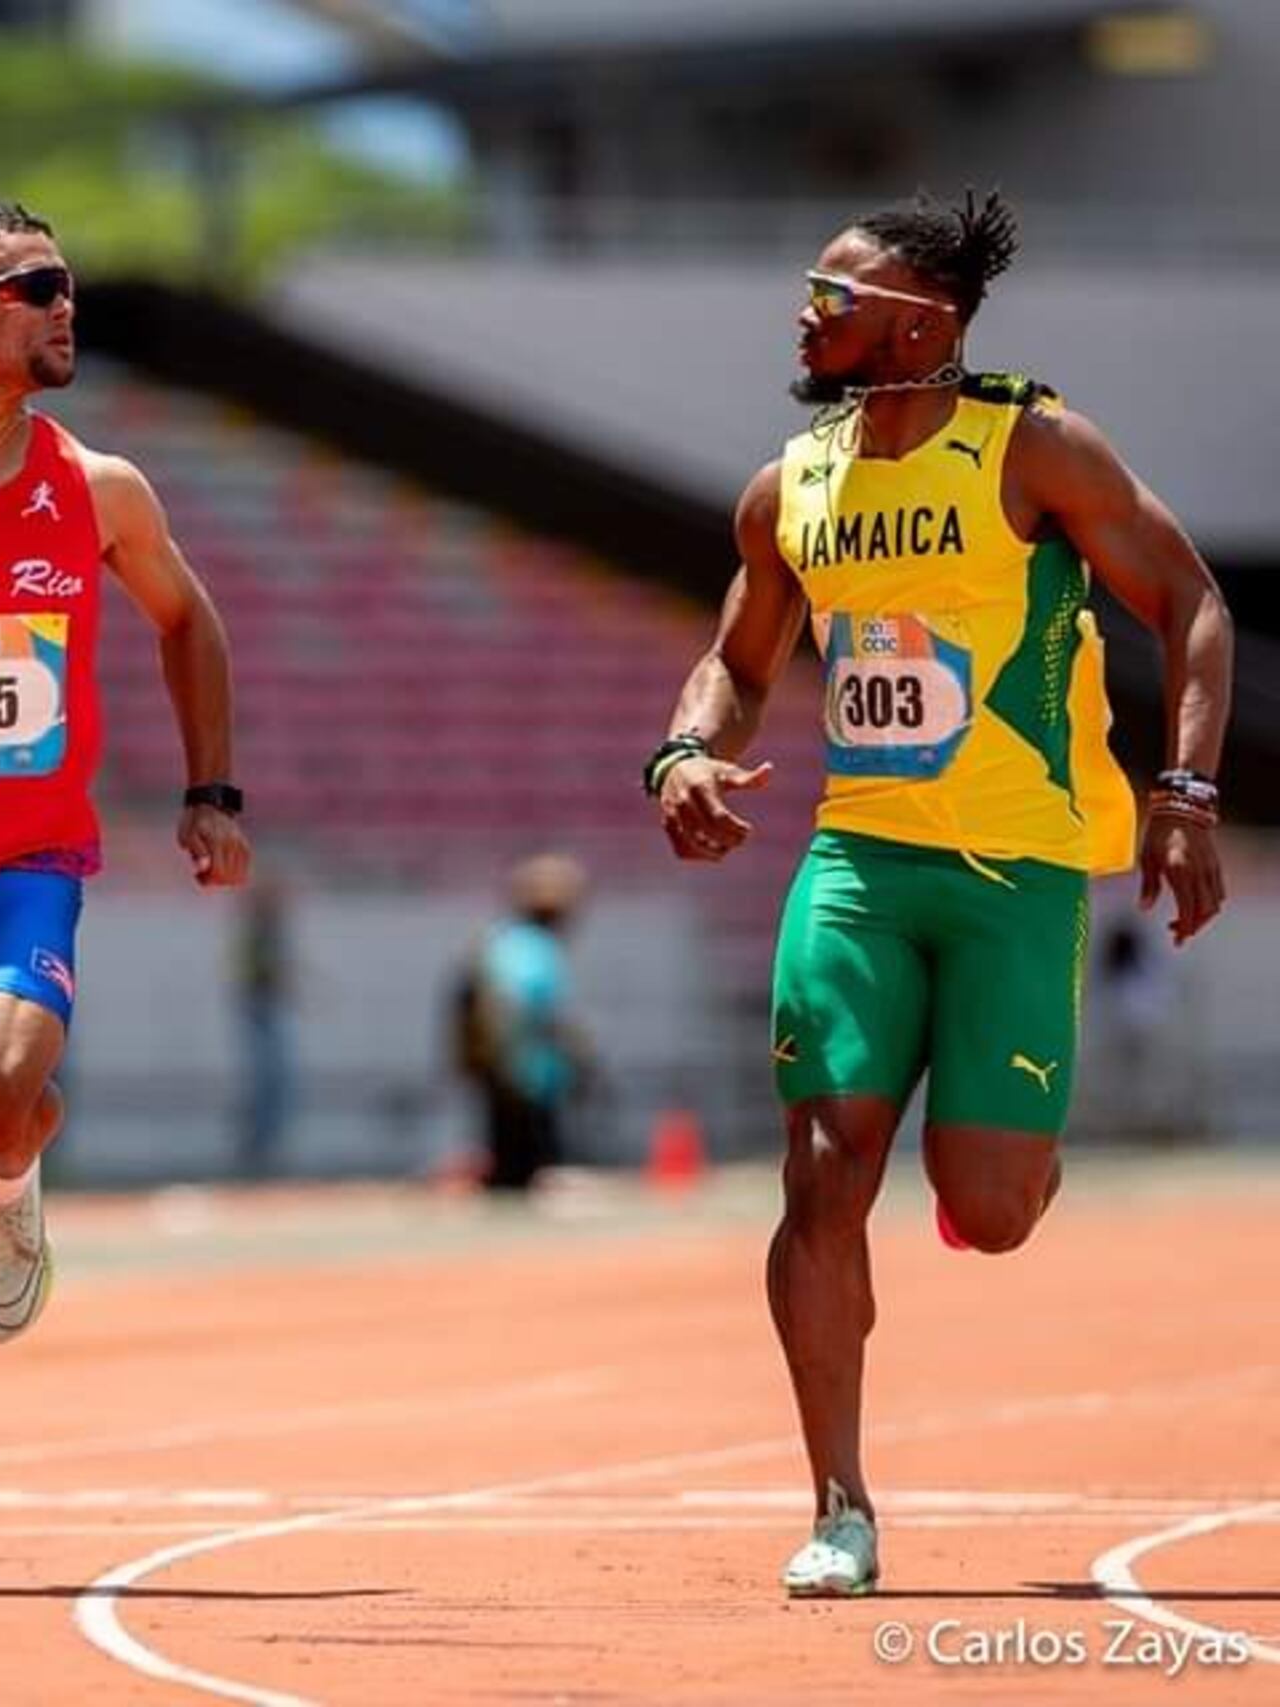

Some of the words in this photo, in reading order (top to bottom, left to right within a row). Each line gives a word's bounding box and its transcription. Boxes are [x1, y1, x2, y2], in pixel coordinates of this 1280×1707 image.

[798, 505, 964, 572] JAMAICA
[11, 559, 84, 598] Rico
[845, 675, 925, 729] 303
